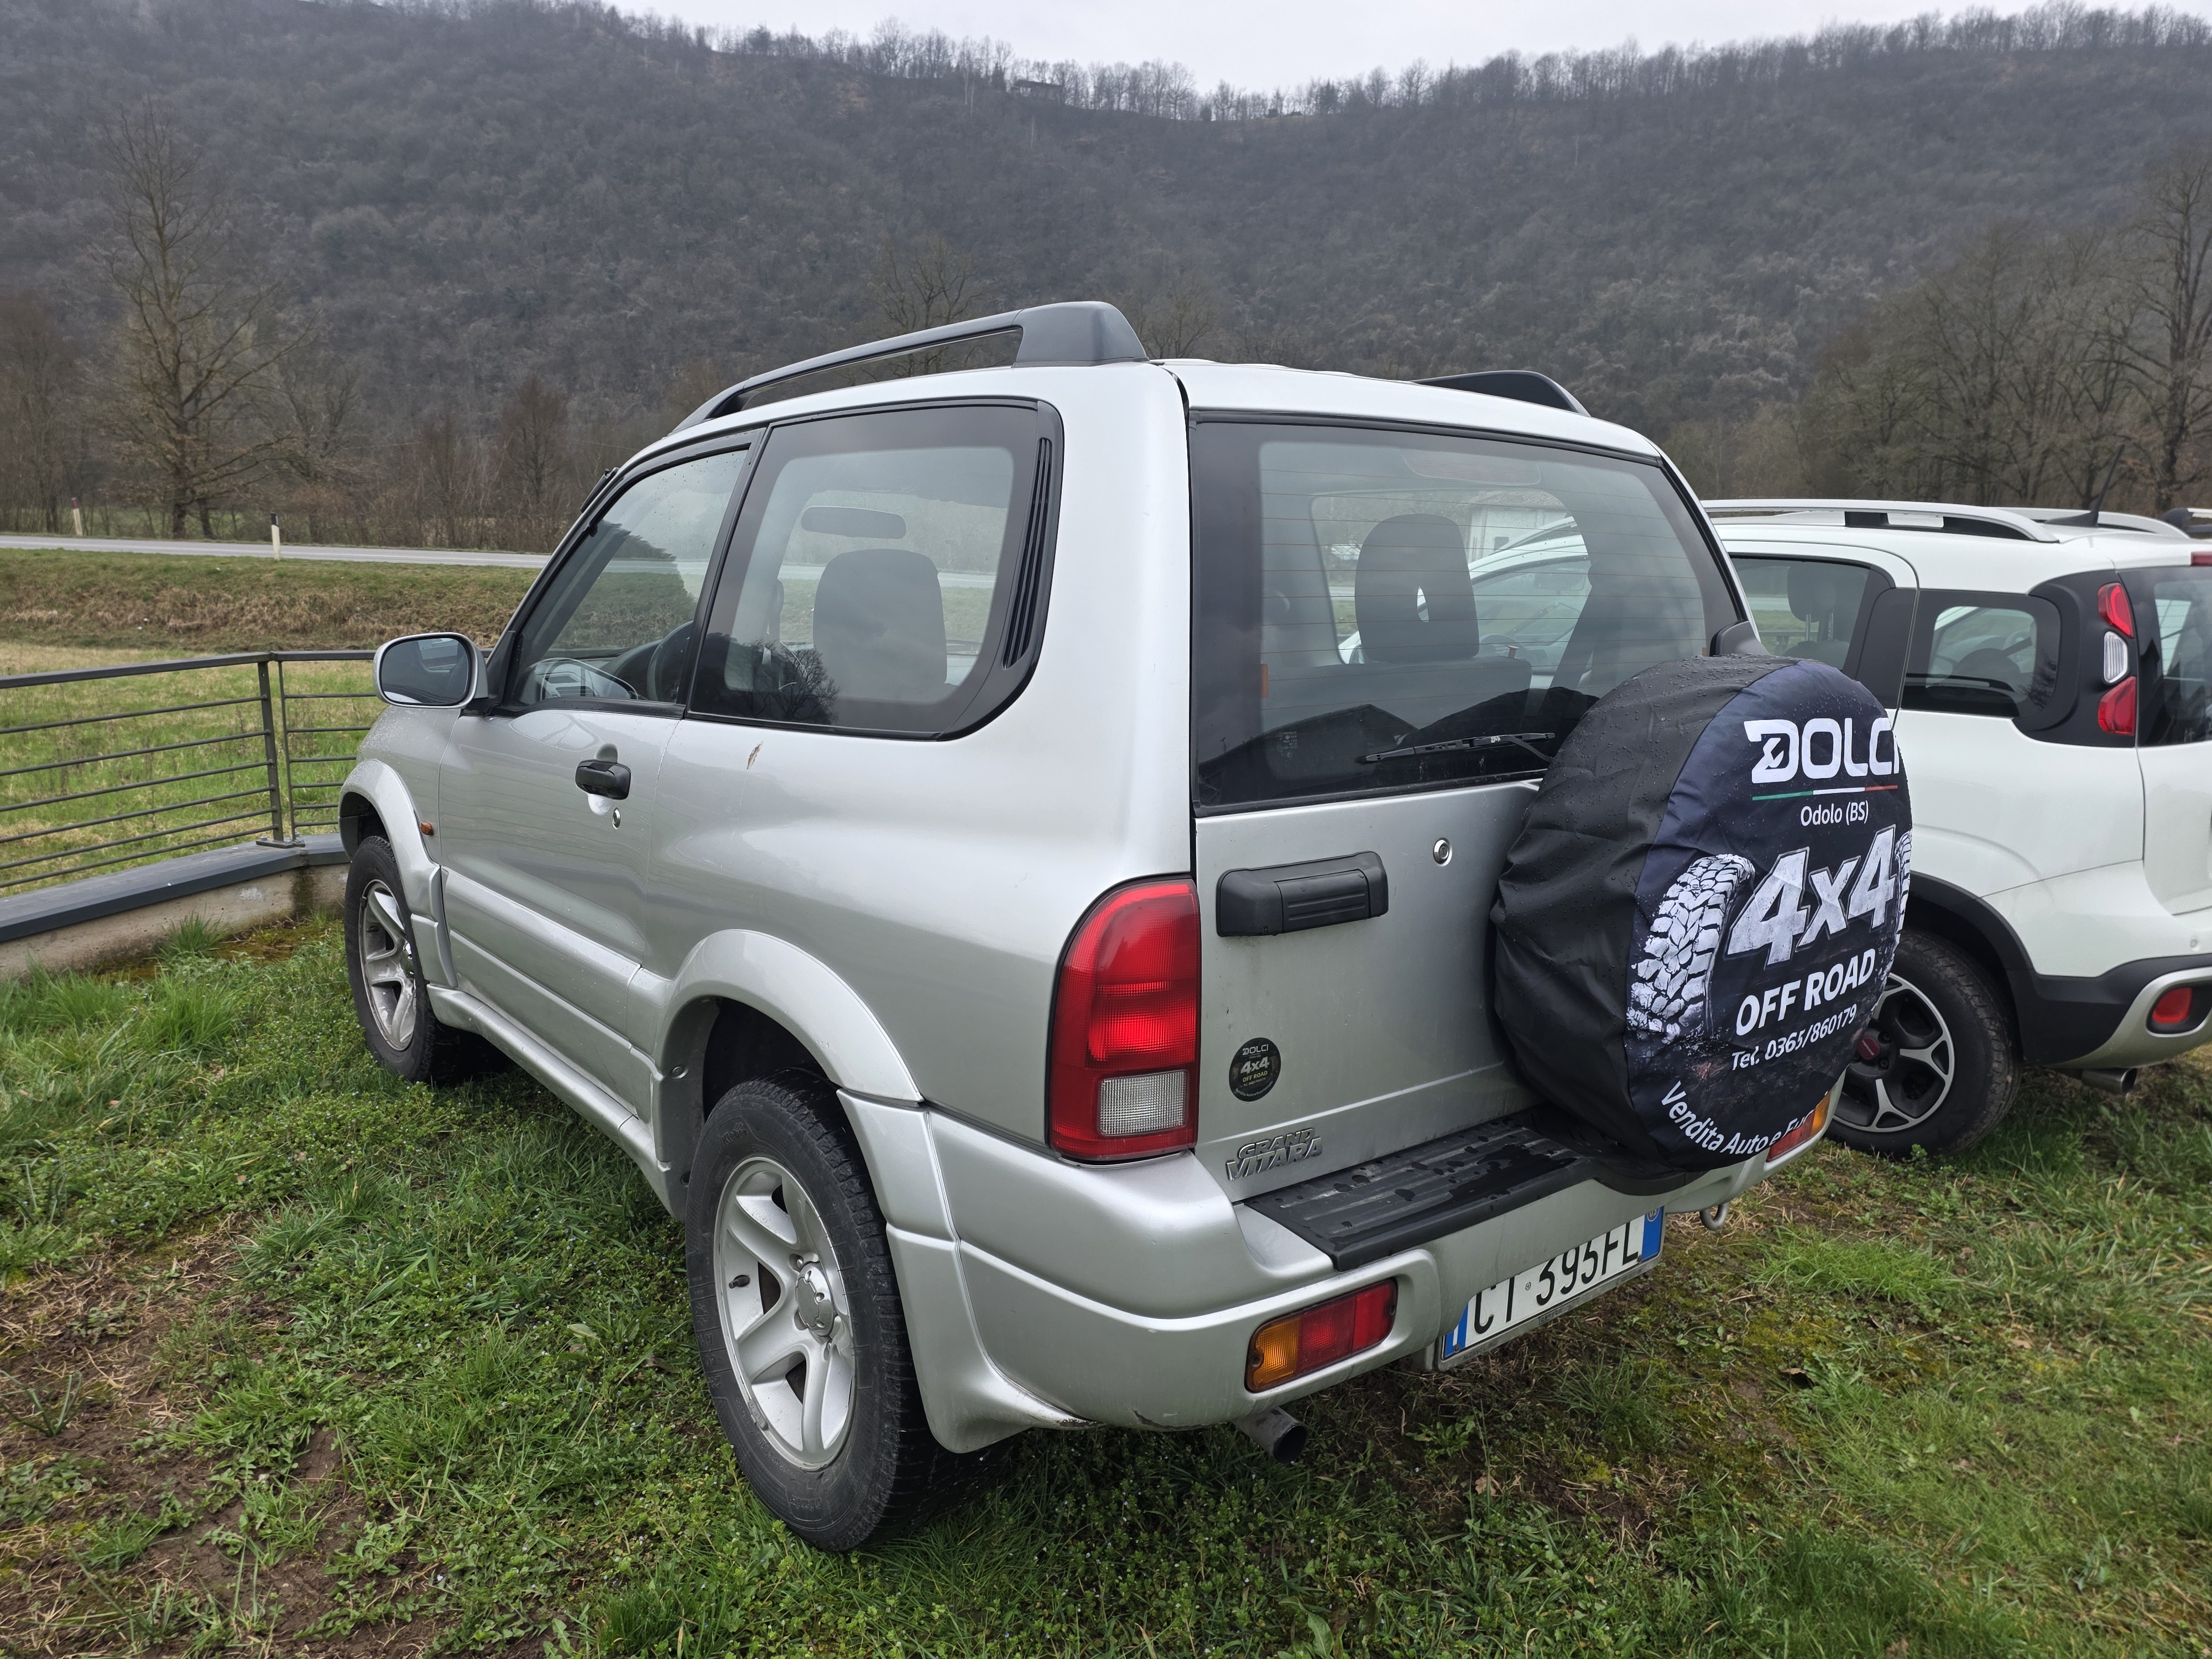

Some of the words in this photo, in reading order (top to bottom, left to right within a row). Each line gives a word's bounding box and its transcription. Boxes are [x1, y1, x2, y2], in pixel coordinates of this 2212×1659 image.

[1801, 804, 1842, 826] Odolo
[1846, 800, 1869, 825] (BS)
[1725, 826, 1897, 968] 4x4
[1736, 980, 1801, 1036] OFF
[1804, 948, 1876, 1011] ROAD
[1242, 1044, 1269, 1056] DOLCI
[1732, 1046, 1760, 1071] Tel.
[1765, 1004, 1856, 1061] 0365/860179
[1240, 1056, 1270, 1074] 4x4
[1253, 1071, 1268, 1079] ROAD
[1661, 1080, 1724, 1151] Vendita
[1720, 1133, 1768, 1155] Auto
[1225, 1137, 1323, 1181] VITARA
[1238, 1128, 1316, 1159] GRAND
